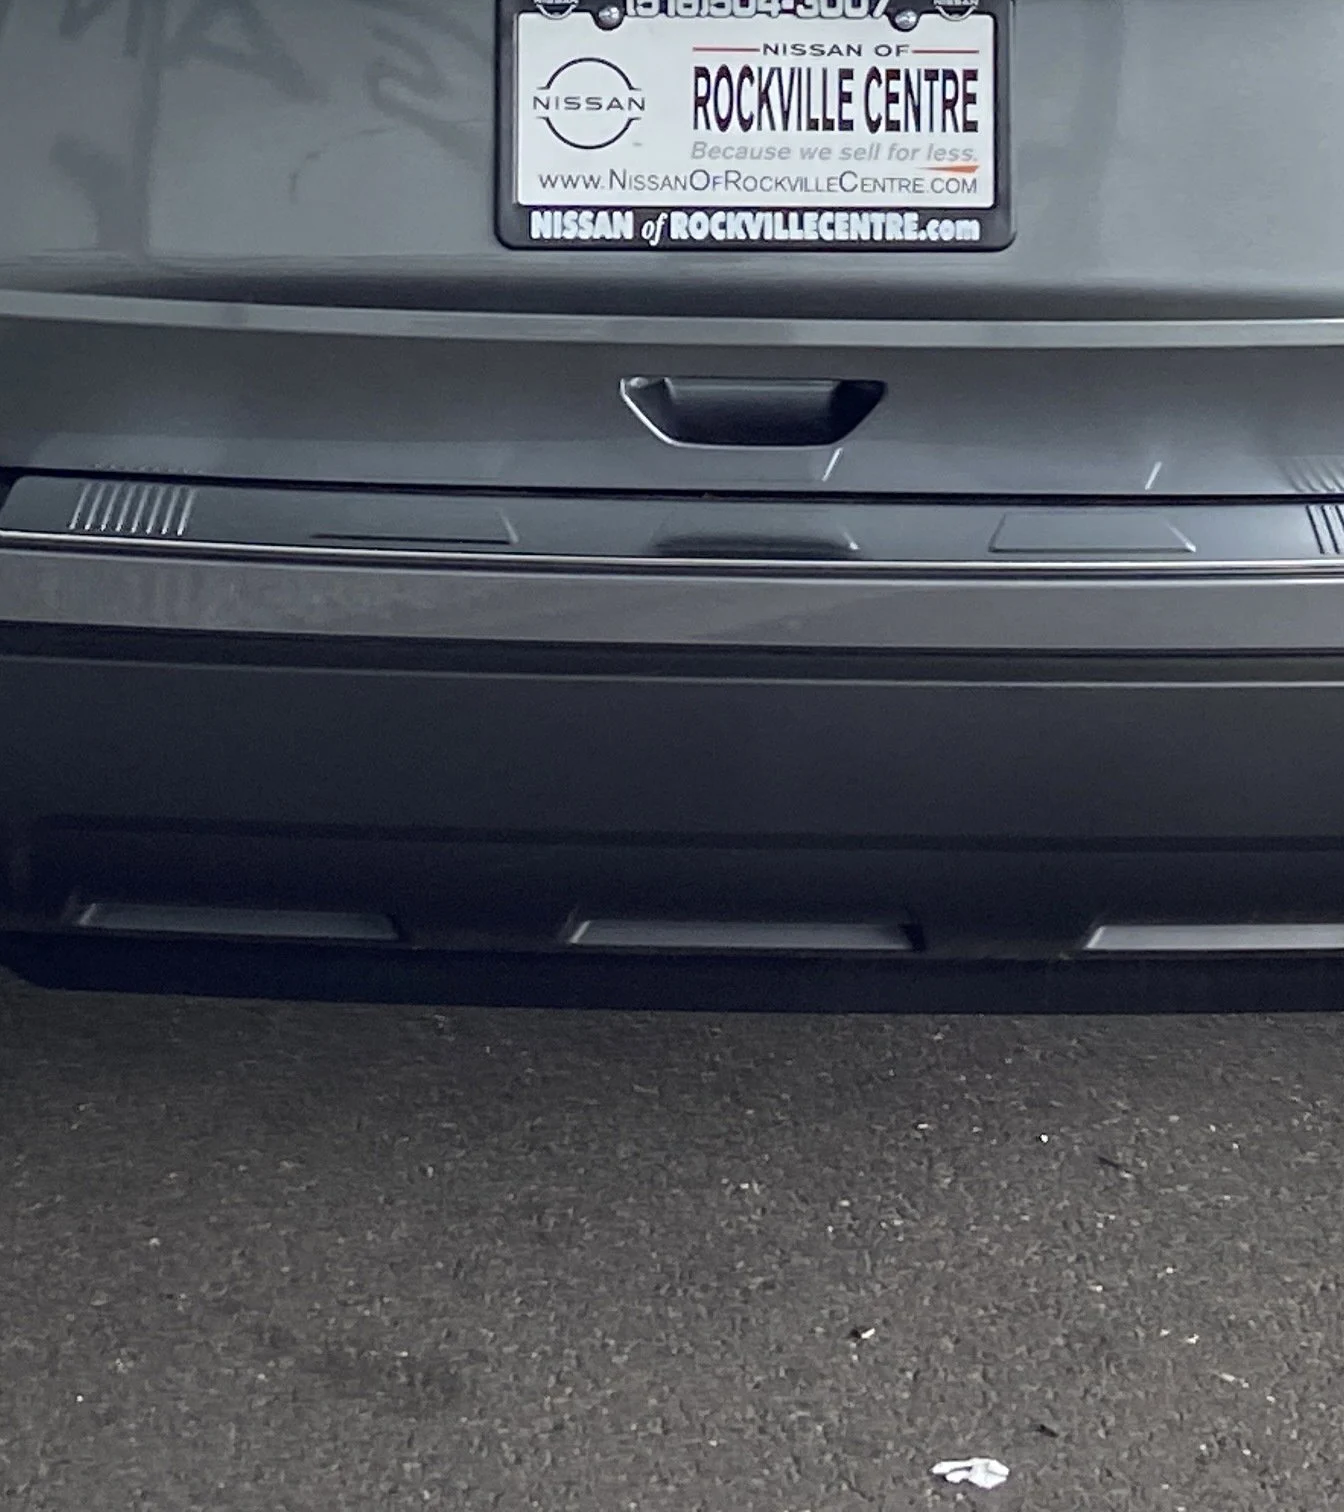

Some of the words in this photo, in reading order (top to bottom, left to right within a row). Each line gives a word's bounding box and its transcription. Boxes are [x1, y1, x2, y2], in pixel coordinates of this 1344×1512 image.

[762, 42, 863, 57] NISSAN
[874, 43, 910, 57] OF
[532, 96, 646, 112] NISSAN
[692, 64, 855, 133] ROCKVILLE
[864, 66, 979, 134] CENTRE
[691, 141, 792, 161] Because
[800, 147, 832, 161] we
[839, 143, 881, 162] sell
[888, 143, 920, 162] for
[927, 144, 979, 163] less.
[530, 210, 634, 241] NISSAN
[641, 211, 668, 246] of
[670, 210, 981, 242] ROCKVILLECENTRE.com
